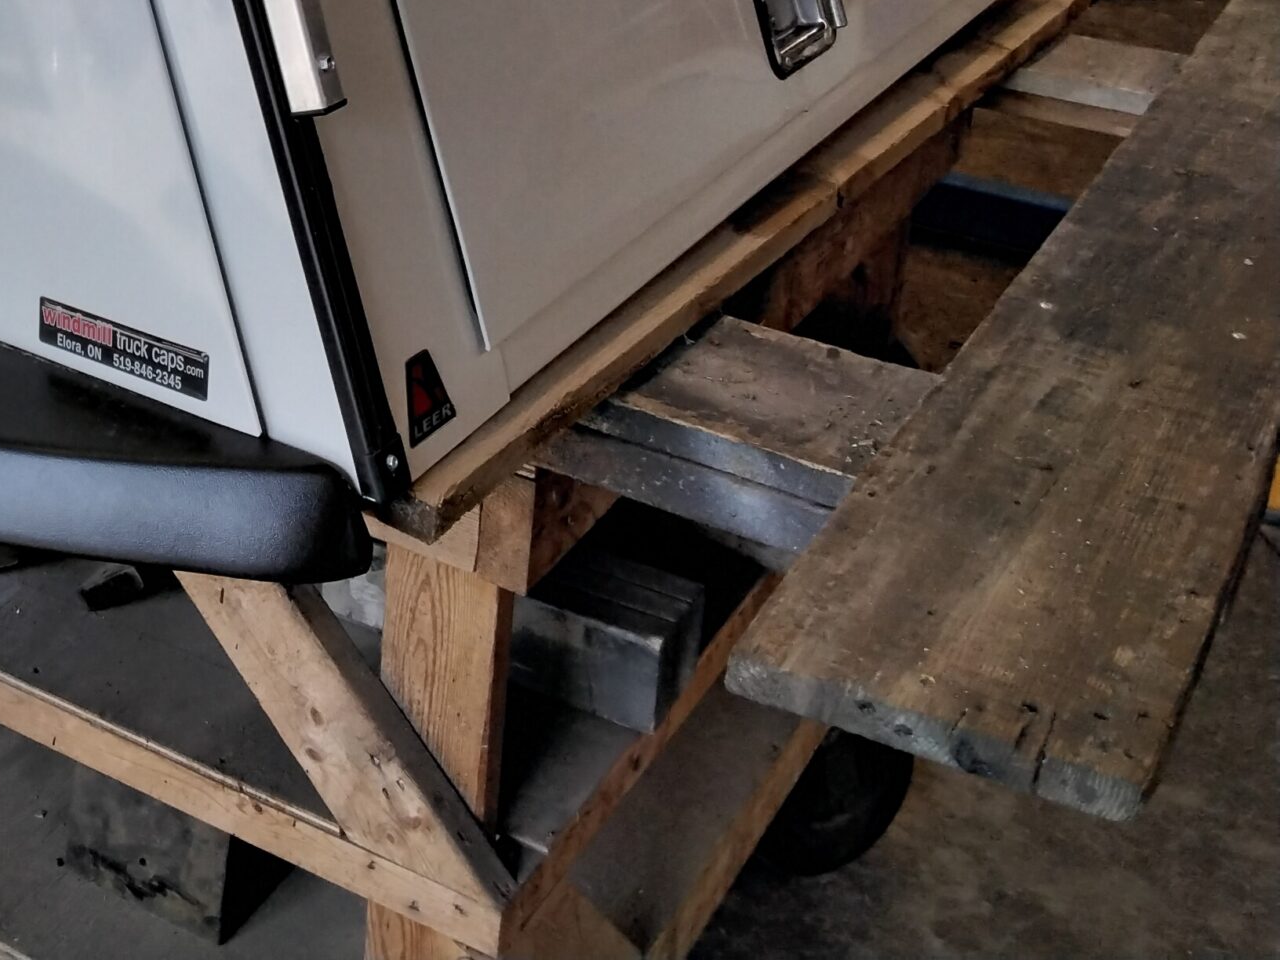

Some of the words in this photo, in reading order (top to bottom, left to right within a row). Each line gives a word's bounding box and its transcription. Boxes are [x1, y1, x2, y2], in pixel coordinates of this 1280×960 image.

[42, 305, 113, 347] windmill
[116, 331, 149, 360] truck
[151, 346, 205, 379] caps.com
[57, 332, 85, 357] Elora,
[87, 344, 102, 361] ON
[112, 355, 182, 390] 519-846-2345
[414, 402, 452, 439] LEER
